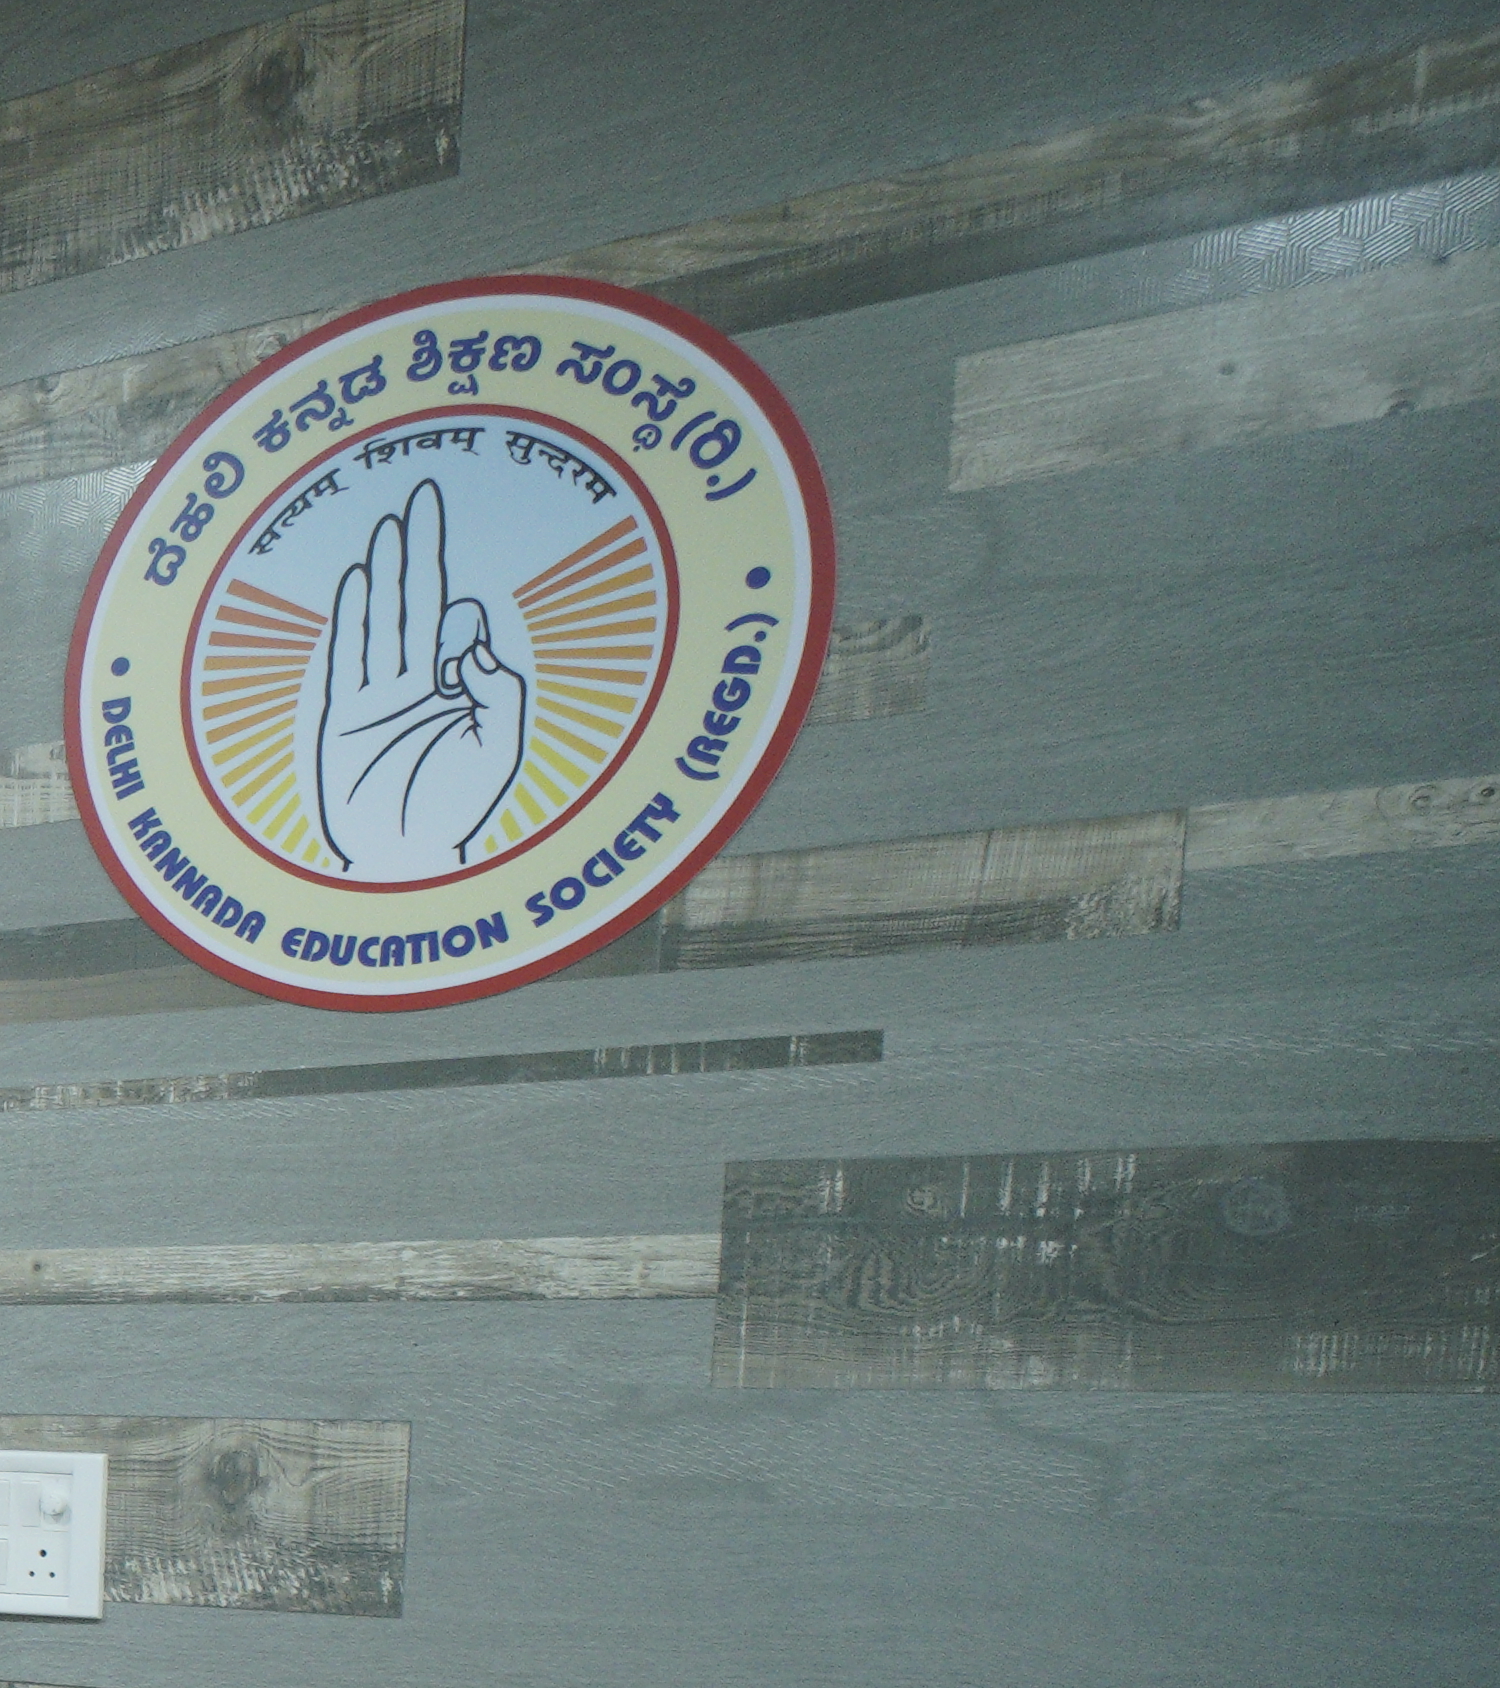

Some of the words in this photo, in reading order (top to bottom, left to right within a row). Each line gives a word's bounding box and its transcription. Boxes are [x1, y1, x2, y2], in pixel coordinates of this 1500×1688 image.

[144, 451, 246, 586] ದೆಹಲಿ
[252, 354, 387, 452] ಕನ್ನಡ
[406, 329, 543, 396] ಶಿಕ್ಷಣ
[353, 426, 486, 470] शिवम्
[101, 695, 146, 801] DELHI
[127, 806, 267, 945] KANNADA
[280, 911, 510, 968] EDUCATION
[524, 792, 681, 928] SOCIETY
[675, 612, 780, 782] (REGD.)
